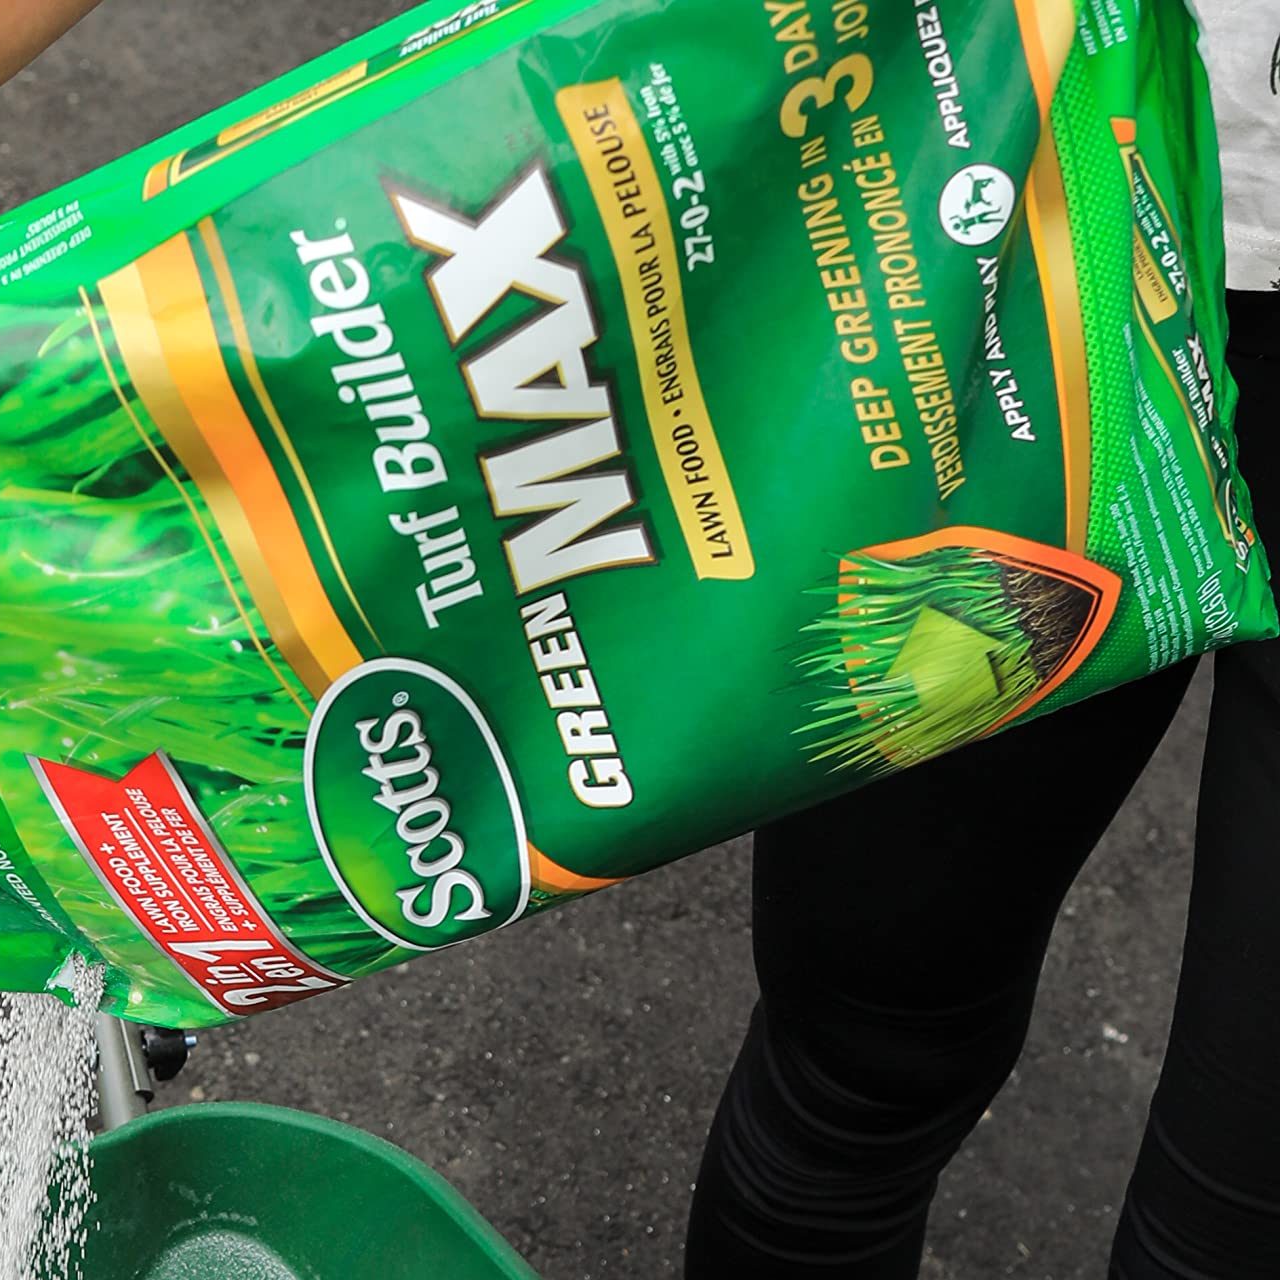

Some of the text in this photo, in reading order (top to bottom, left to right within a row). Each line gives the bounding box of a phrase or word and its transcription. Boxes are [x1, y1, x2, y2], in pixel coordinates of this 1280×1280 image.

[640, 85, 662, 119] Iron
[779, 53, 874, 139] 3
[916, 5, 971, 149] APPLIQUEZ
[660, 142, 682, 176] with
[679, 134, 698, 168] avec
[799, 135, 828, 169] IN
[851, 114, 885, 148] EN
[672, 169, 715, 273] 27-0-2
[842, 151, 927, 310] PRONONCÉ
[797, 172, 880, 365] GREENING
[584, 103, 734, 560] LAWN FOOD ENGRAIS POUR LA PELOUSE
[984, 313, 1007, 360] AND
[389, 163, 658, 595] MAX
[893, 318, 967, 501] VERDISSEMENT
[988, 367, 1037, 442] APPLY
[849, 376, 910, 470] DEEP
[389, 505, 484, 629] Turf
[519, 591, 634, 809] GREEN
[160, 807, 186, 830] FER
[179, 828, 200, 848] DE
[354, 707, 493, 929] Scotts
[101, 812, 201, 932] IRON SUPPLEMENT
[108, 857, 142, 896] FOOD
[125, 787, 239, 933] ENGRAIS POUR LA PELOUSE
[191, 848, 249, 917] SUPPLÉMENT
[136, 896, 177, 934] LAWN
[166, 939, 337, 1007] 2 in 1
[250, 955, 305, 979] en
